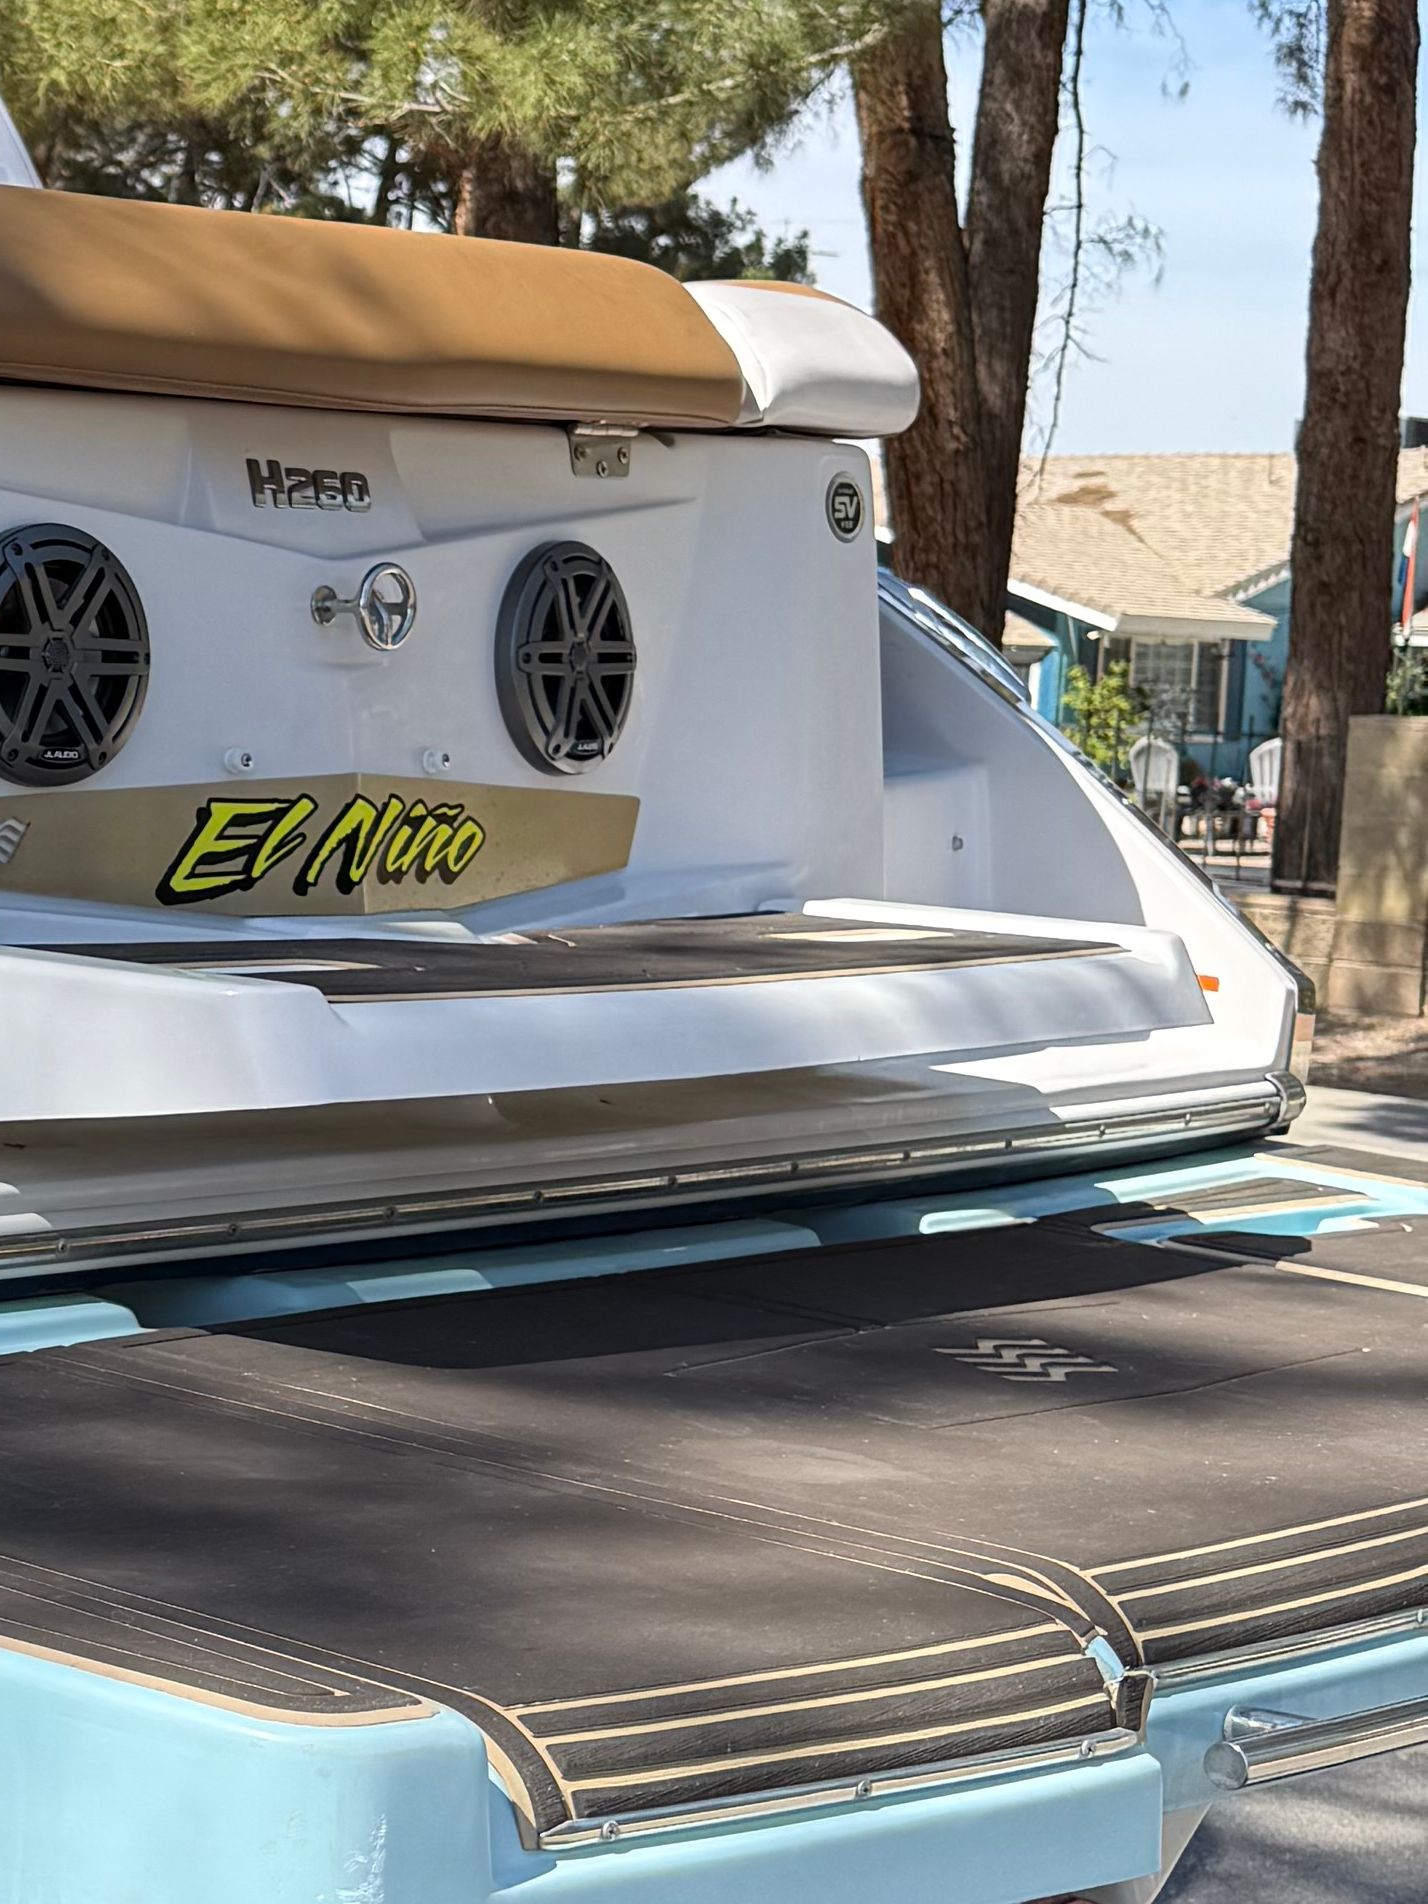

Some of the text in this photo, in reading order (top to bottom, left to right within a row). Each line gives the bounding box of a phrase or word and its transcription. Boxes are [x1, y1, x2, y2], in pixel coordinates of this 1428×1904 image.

[245, 457, 372, 513] H260
[155, 793, 487, 907] El Niño
